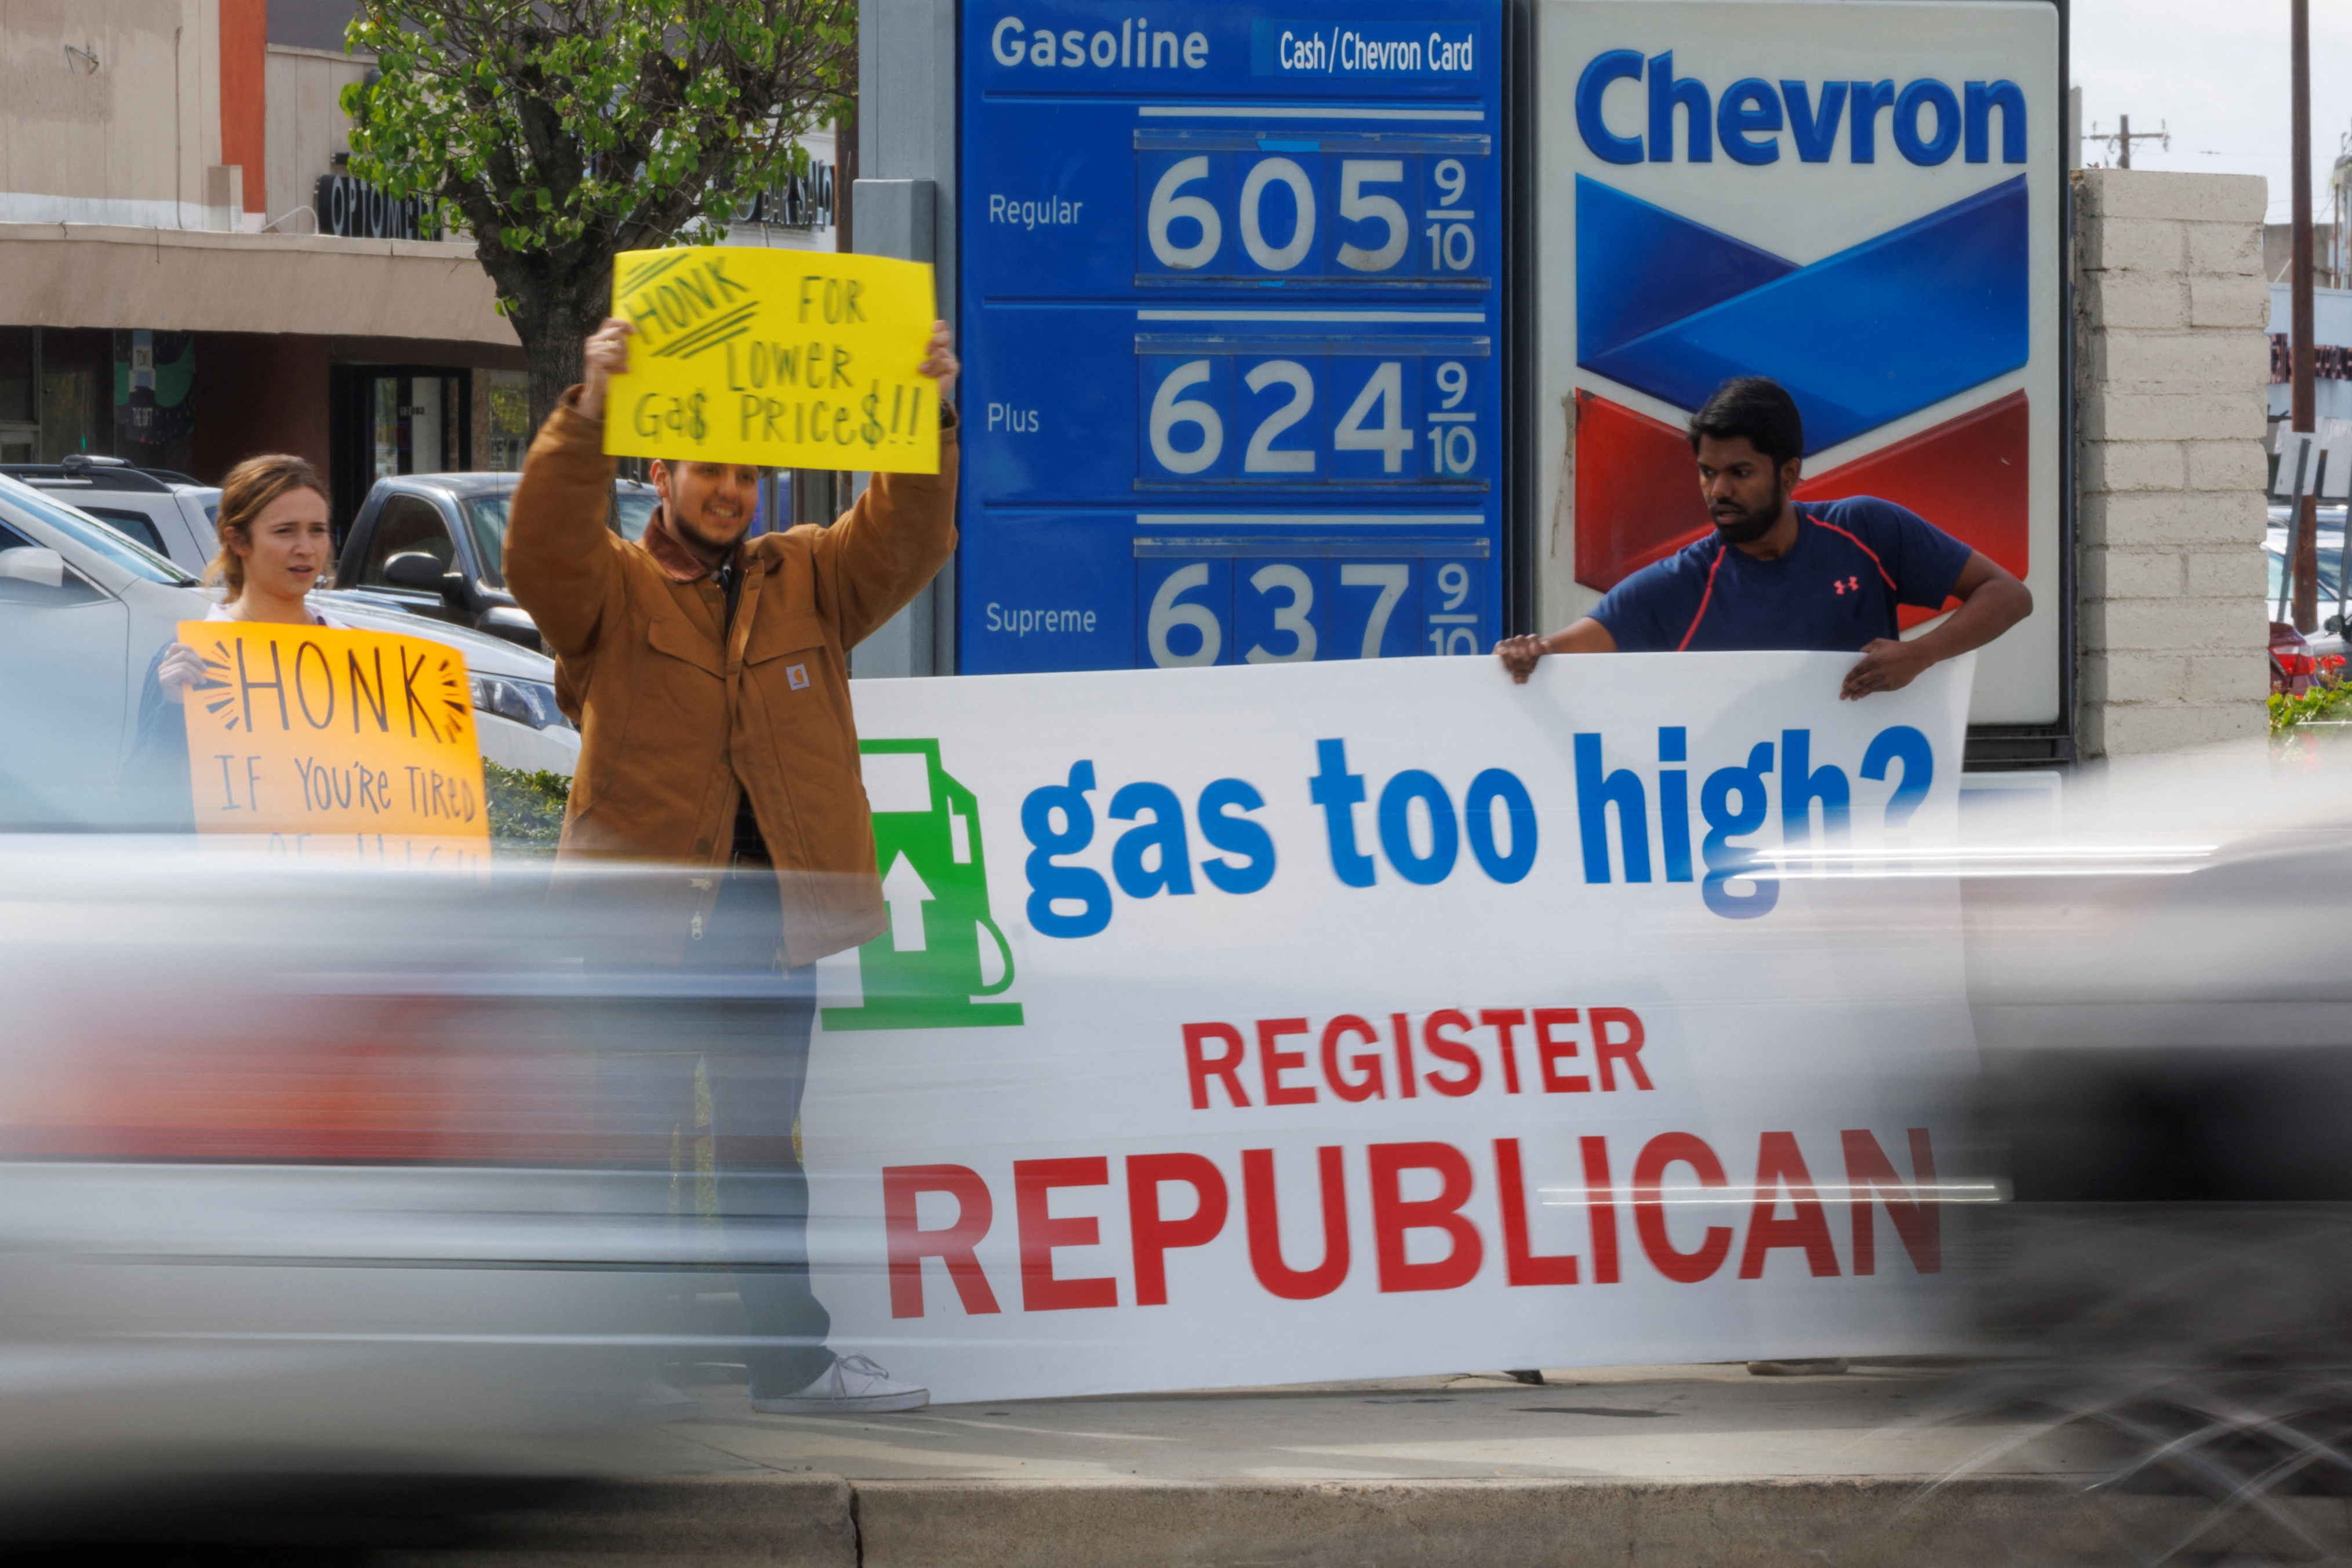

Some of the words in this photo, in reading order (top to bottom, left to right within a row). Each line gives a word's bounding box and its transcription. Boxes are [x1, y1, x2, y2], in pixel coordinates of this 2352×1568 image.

[991, 16, 1209, 70] Gasoline
[1428, 32, 1473, 71] Card
[1575, 49, 2027, 166] Chevron
[990, 194, 1083, 230] Regular
[1147, 156, 1409, 272] 605
[623, 256, 749, 345] HONK
[798, 275, 868, 324] FOR
[988, 403, 1039, 432] Plus
[1149, 359, 1413, 474] 624
[986, 603, 1096, 636] Supreme
[1147, 563, 1409, 666] 637
[236, 638, 443, 744] HONK
[214, 755, 262, 811] IF
[1021, 759, 1277, 938] gas
[1308, 737, 1538, 885] too
[1573, 725, 1933, 920] high?
[1182, 1007, 1655, 1110] REGISTER
[882, 1127, 1942, 1319] REPUBLICAN
